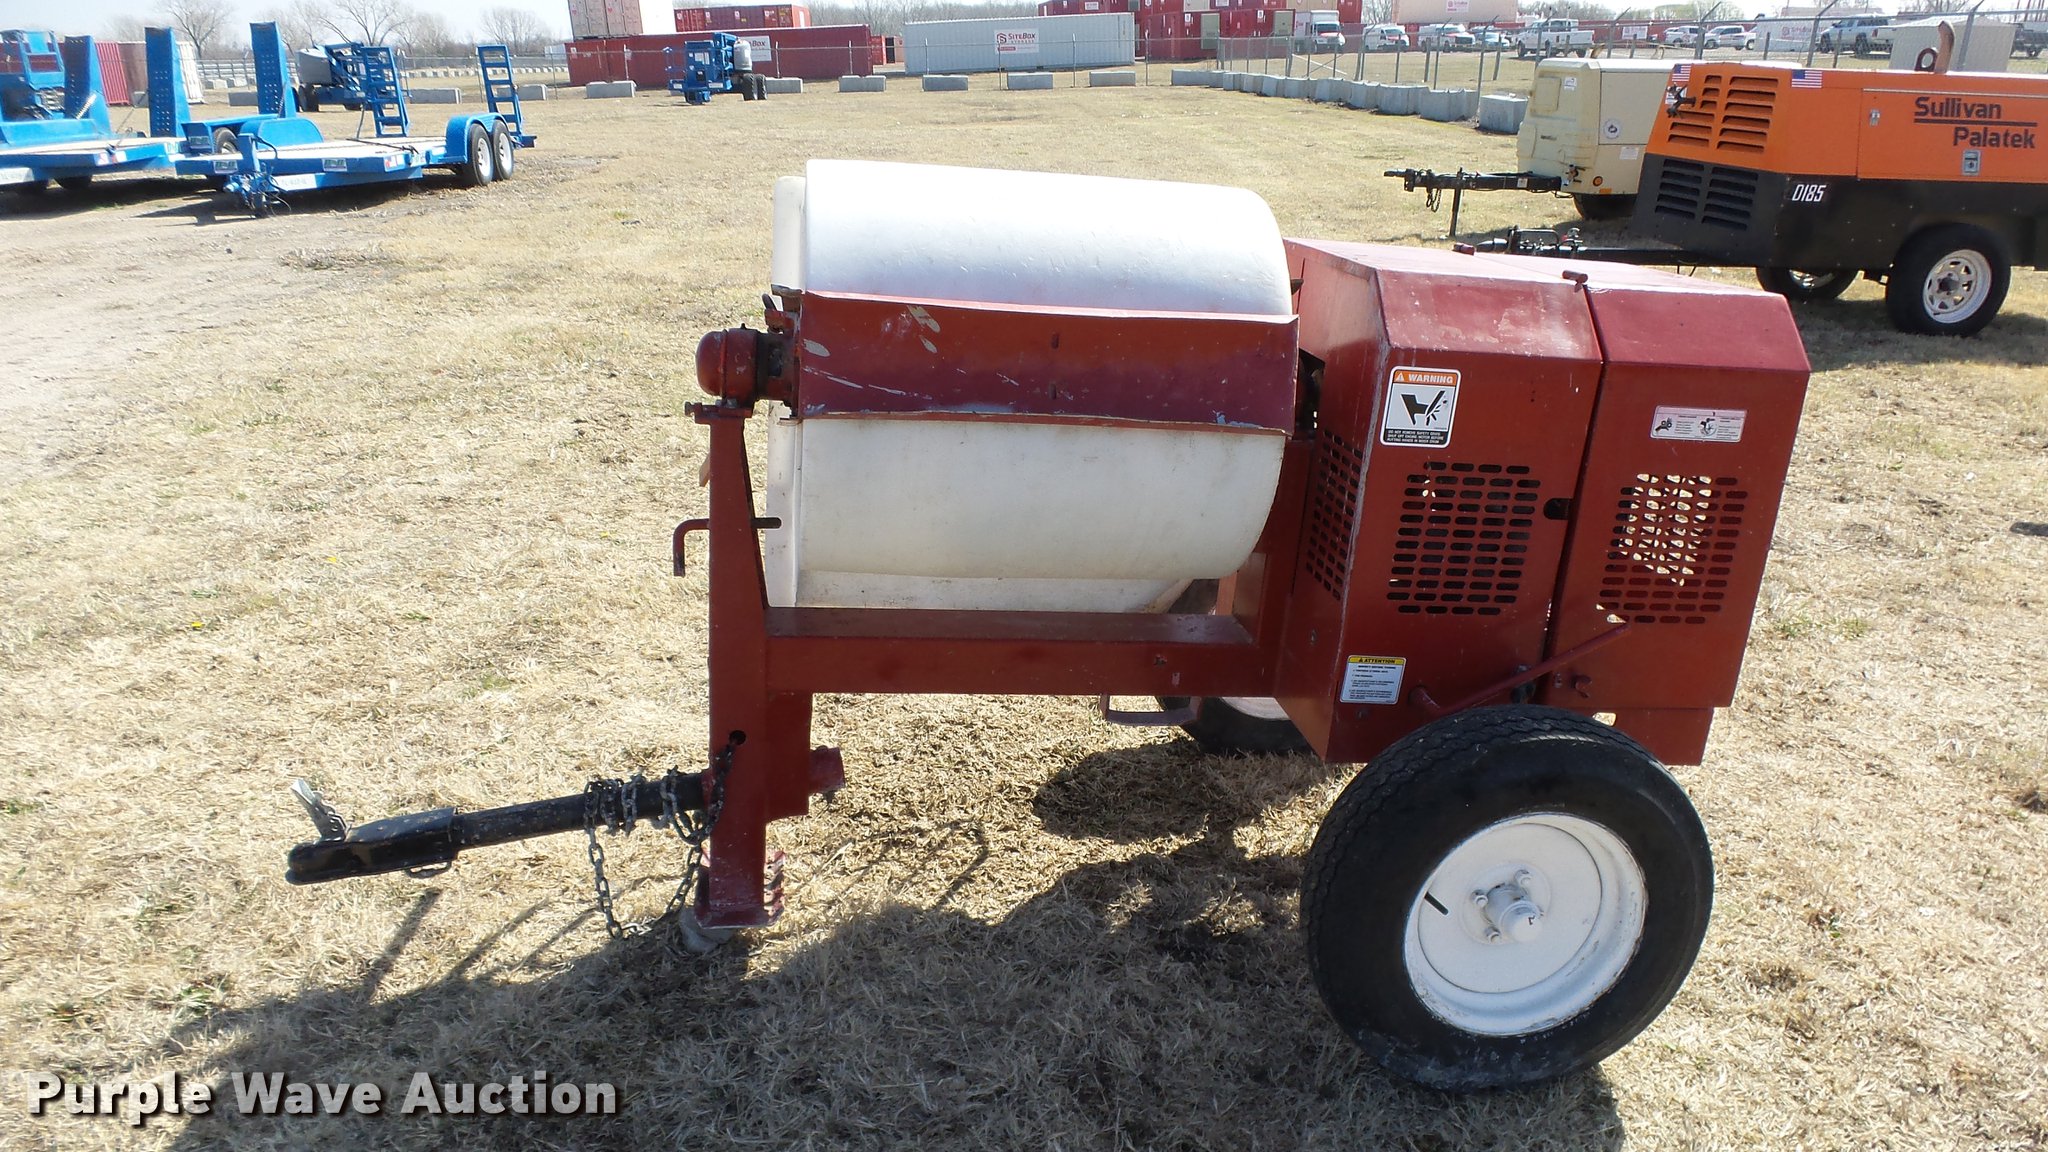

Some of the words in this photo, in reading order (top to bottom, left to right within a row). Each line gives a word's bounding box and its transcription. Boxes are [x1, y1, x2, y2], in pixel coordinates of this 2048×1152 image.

[1914, 96, 2002, 119] Sullivan
[1953, 127, 2036, 149] Palatek
[1408, 373, 1454, 384] WARNING
